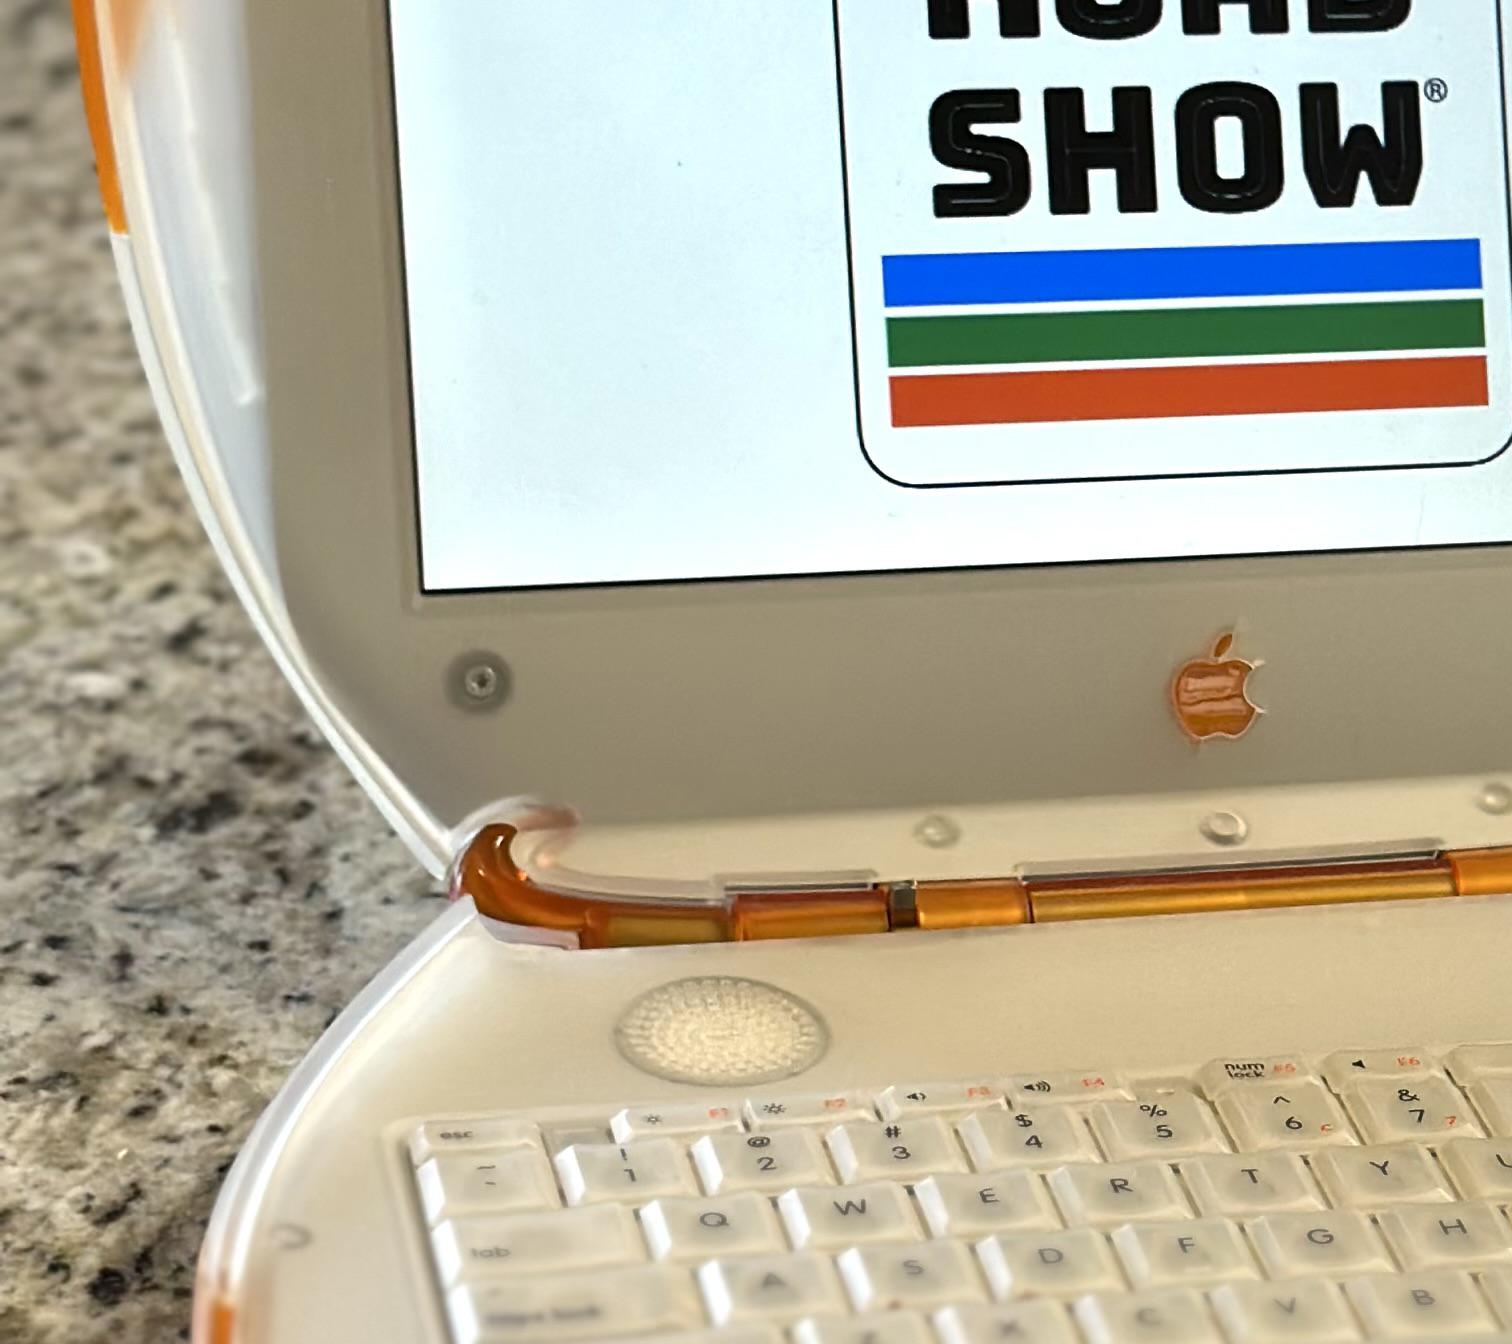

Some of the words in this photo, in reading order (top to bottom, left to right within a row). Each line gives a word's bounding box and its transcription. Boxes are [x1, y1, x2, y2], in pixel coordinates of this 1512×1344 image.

[1224, 1061, 1265, 1072] num
[1227, 1069, 1265, 1080] lock
[1397, 1088, 1421, 1102] &
[1139, 1103, 1169, 1118] %
[1408, 1107, 1425, 1124] 7
[1014, 1112, 1034, 1129] $
[1285, 1116, 1304, 1131] 6
[884, 1124, 903, 1140] #
[1155, 1123, 1174, 1139] 5
[747, 1135, 771, 1149] @
[1024, 1134, 1044, 1150] 4
[891, 1145, 912, 1160] 3
[757, 1156, 778, 1171] 2
[1368, 1159, 1390, 1176] Y
[623, 1167, 637, 1183] 1
[1240, 1167, 1259, 1184] T
[1109, 1177, 1134, 1194] R
[977, 1186, 1000, 1205] E
[832, 1198, 868, 1217] W
[699, 1210, 731, 1228] Q
[1437, 1218, 1468, 1235] H
[1306, 1227, 1335, 1245] G
[1176, 1236, 1197, 1254] F
[1037, 1247, 1065, 1264] D
[902, 1259, 925, 1276] S
[761, 1271, 786, 1290] A
[1272, 1296, 1298, 1315] V
[1410, 1288, 1437, 1307] B
